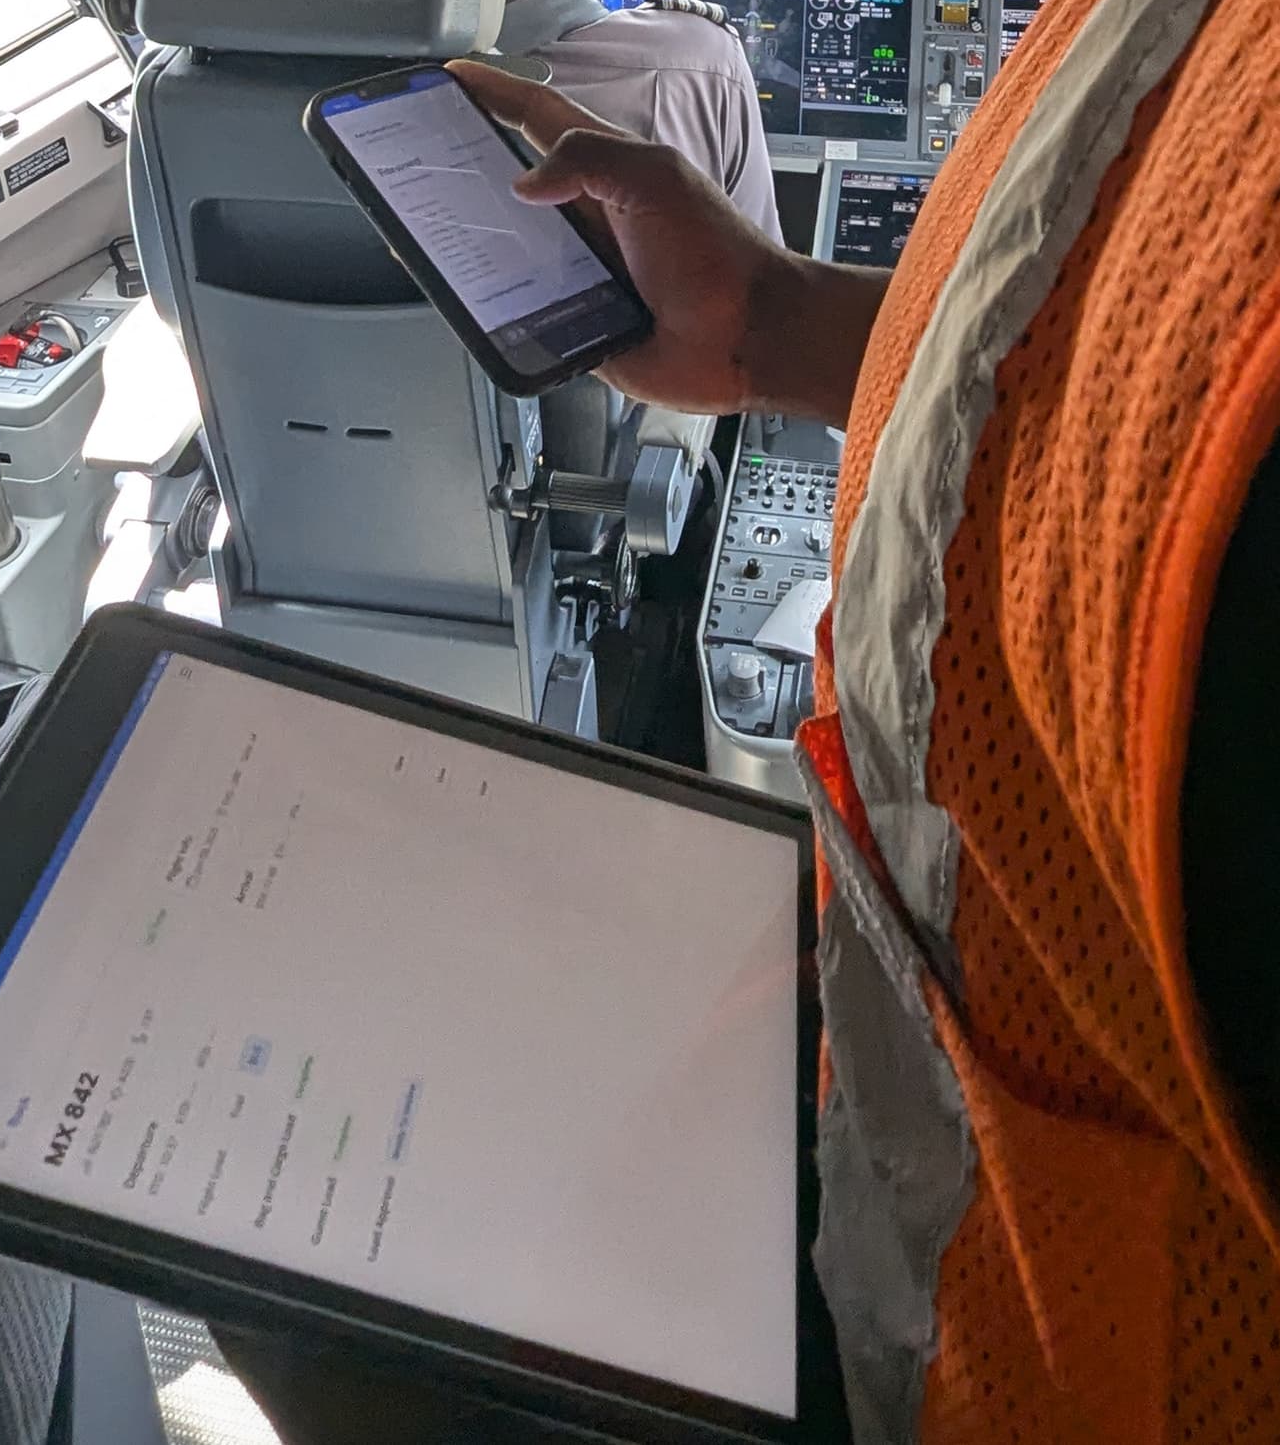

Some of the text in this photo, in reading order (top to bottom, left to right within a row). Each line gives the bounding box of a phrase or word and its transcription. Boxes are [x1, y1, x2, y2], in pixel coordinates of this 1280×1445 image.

[43, 1122, 78, 1167] MX
[64, 1071, 101, 1120] 842
[122, 1121, 159, 1190] Departure
